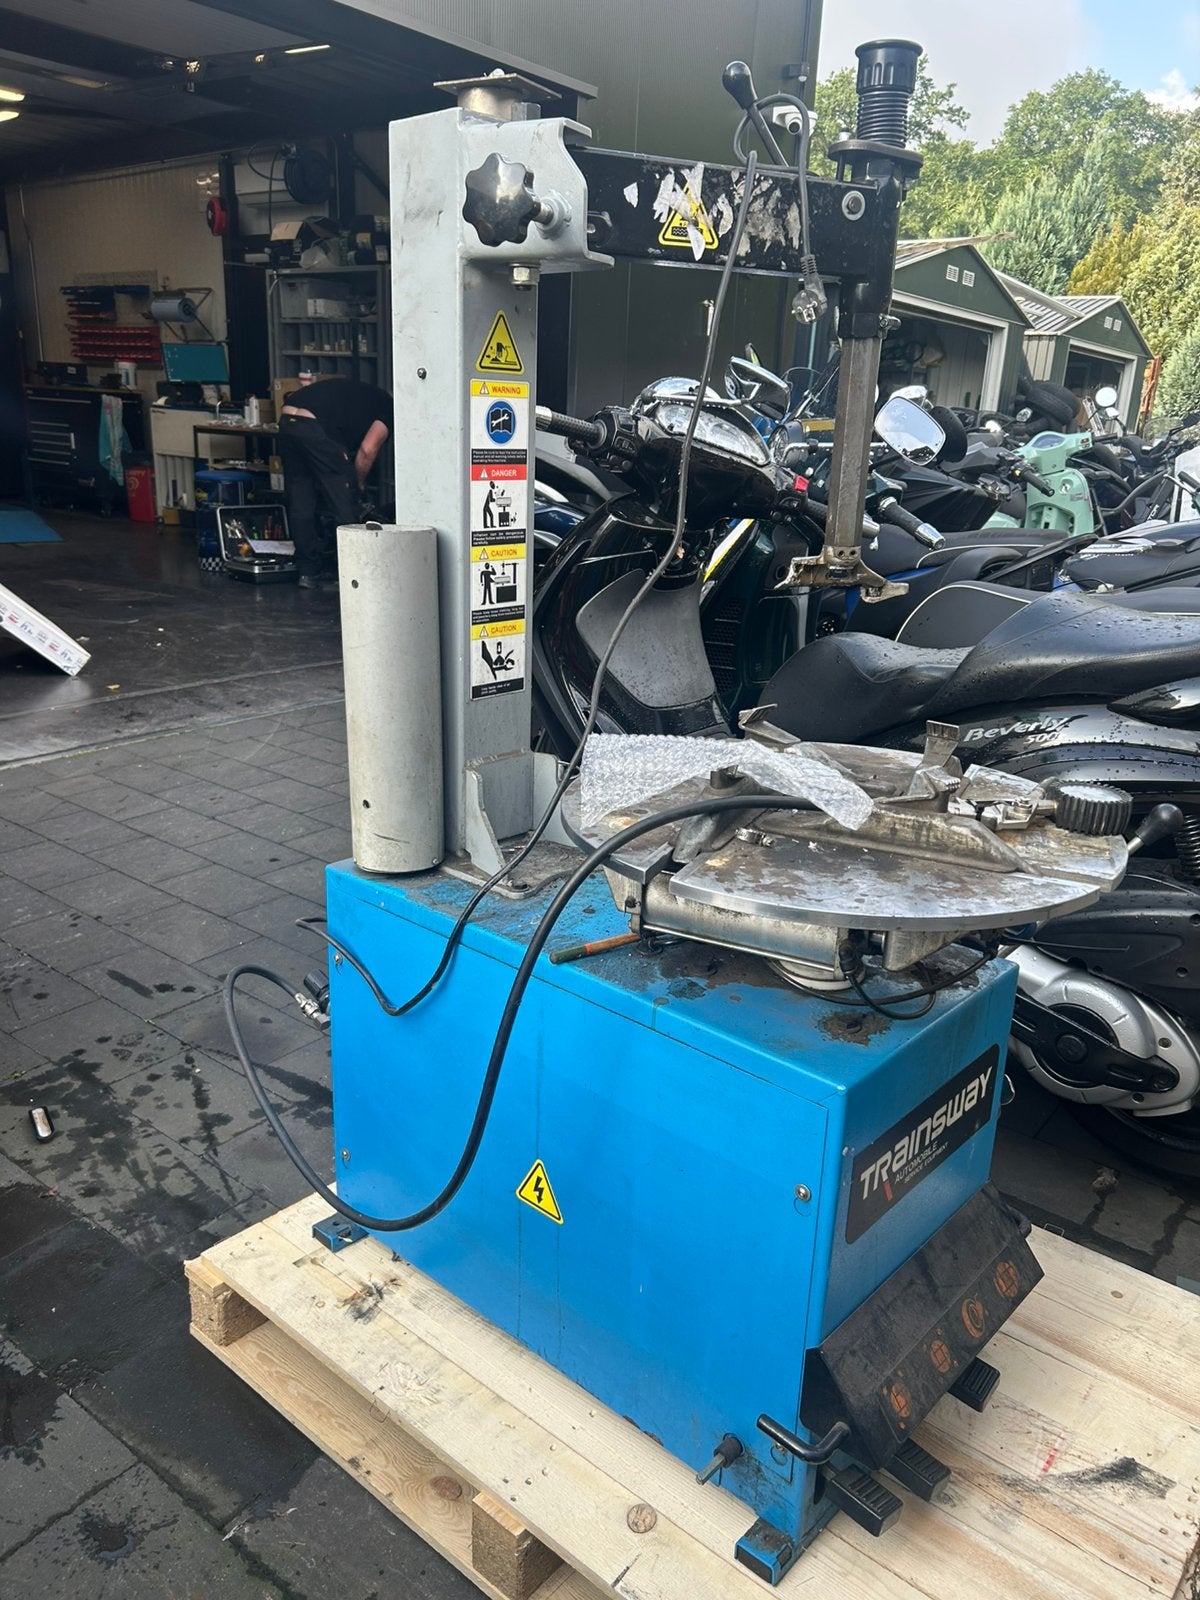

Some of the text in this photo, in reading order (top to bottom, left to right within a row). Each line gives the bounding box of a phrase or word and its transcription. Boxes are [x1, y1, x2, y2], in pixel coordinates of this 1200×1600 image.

[492, 385, 521, 395] WARNING
[491, 469, 517, 477] DANGER
[491, 549, 517, 557] CAUTION
[491, 625, 517, 634] CAUTION
[963, 717, 1072, 742] Beverly
[1023, 732, 1060, 744] 500
[894, 1141, 938, 1185] AUTOMOBILE
[904, 1141, 949, 1184] SERVICE EQUIPMENT
